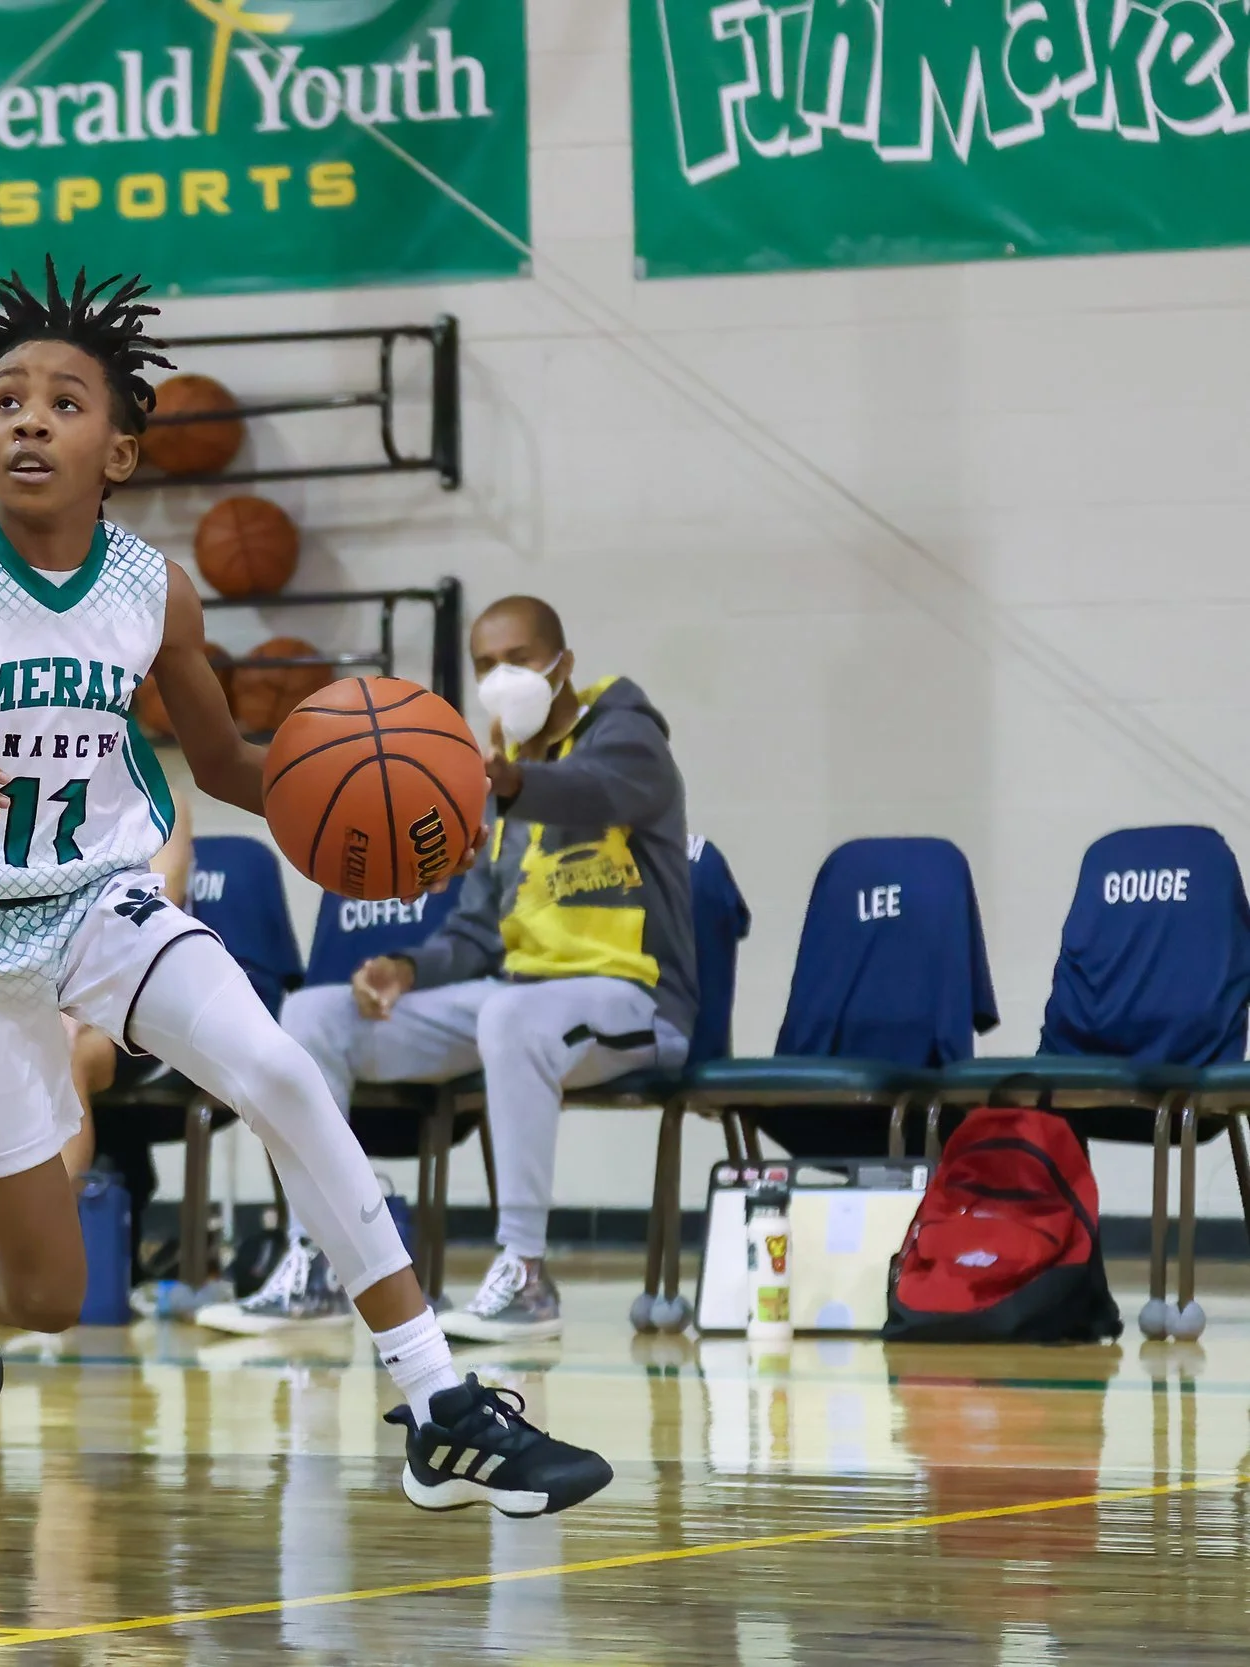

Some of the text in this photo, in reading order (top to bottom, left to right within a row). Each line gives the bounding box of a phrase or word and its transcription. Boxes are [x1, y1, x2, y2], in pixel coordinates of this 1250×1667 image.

[236, 28, 490, 132] Youth
[857, 883, 902, 923] LEE
[1103, 868, 1191, 905] GOUGE
[339, 893, 428, 932] COFFEY
